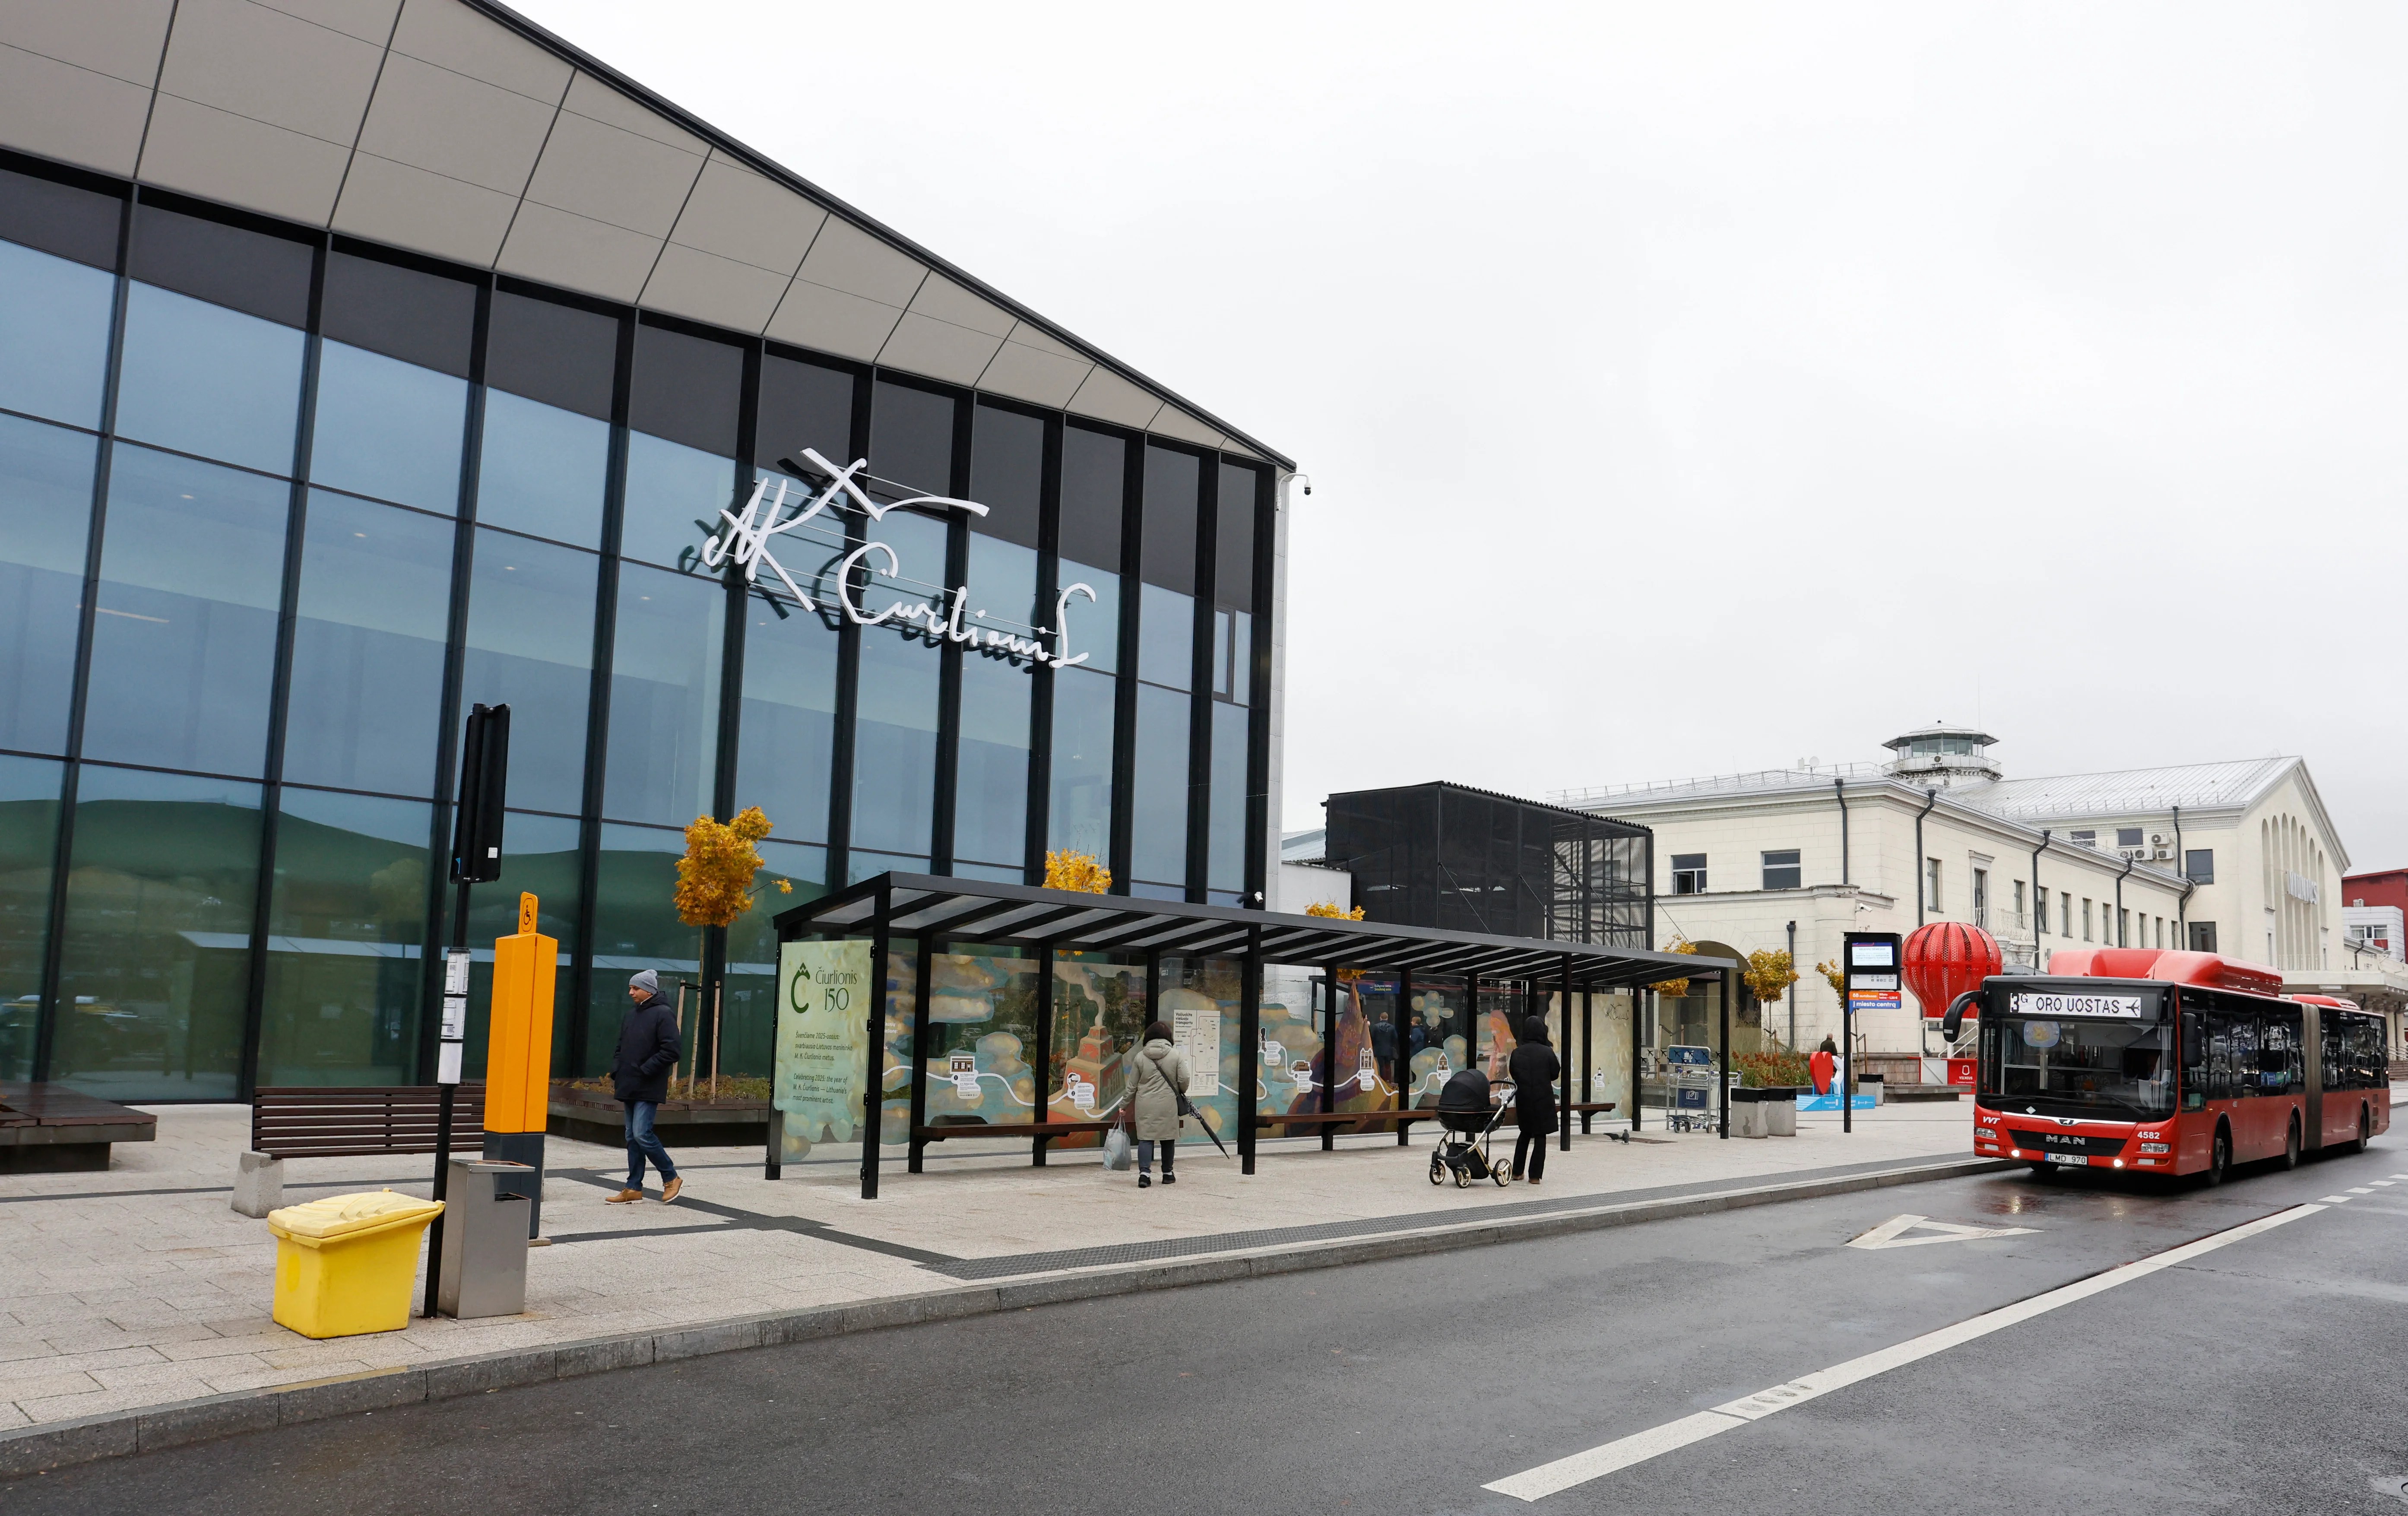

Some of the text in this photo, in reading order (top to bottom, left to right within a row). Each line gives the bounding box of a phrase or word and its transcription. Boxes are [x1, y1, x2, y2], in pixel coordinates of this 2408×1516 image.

[815, 966, 857, 985] Čiurlionis
[824, 987, 849, 1013] 150
[2036, 997, 2062, 1012] ORO
[2067, 998, 2120, 1014] UOSTAS
[795, 1030, 815, 1039] Švenčiame
[804, 1052, 821, 1060] Čiurlionio
[794, 1073, 814, 1082] Celebrating
[803, 1083, 820, 1091] Čiurlionis
[2046, 1134, 2085, 1145] MAN
[2137, 1131, 2160, 1139] 4582
